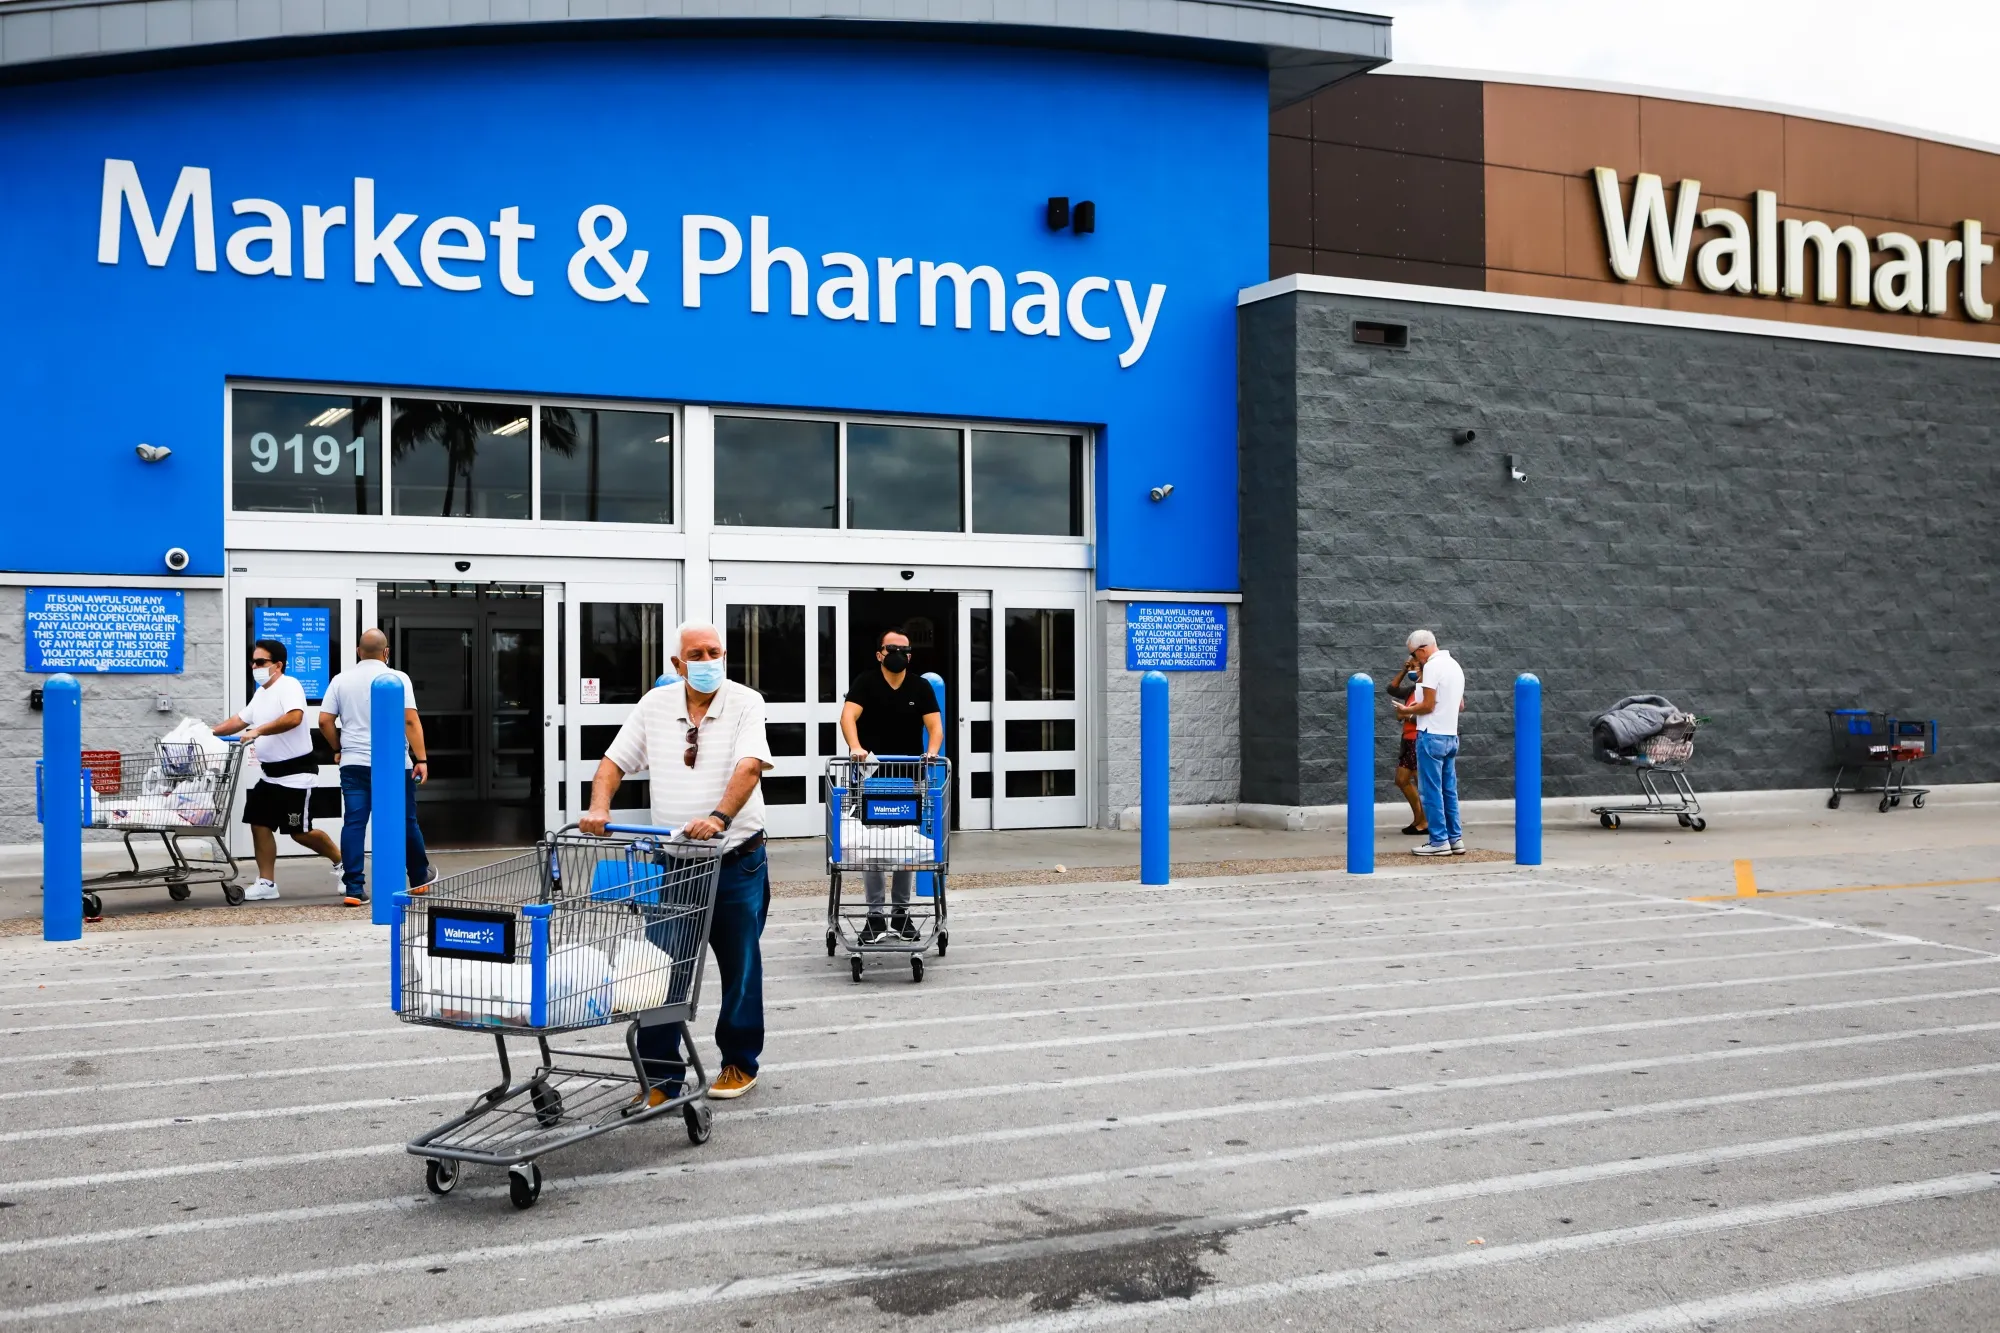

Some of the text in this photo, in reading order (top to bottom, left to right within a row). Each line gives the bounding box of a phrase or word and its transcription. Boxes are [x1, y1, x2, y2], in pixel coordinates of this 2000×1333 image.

[1594, 166, 1994, 321] Walmart
[97, 158, 1168, 369] Market & Pharmacy
[250, 432, 364, 476] 9191
[48, 594, 162, 604] IT IS UNLAWFUL FOR ANY
[45, 604, 82, 612] PERSON
[85, 604, 98, 612] TO
[29, 613, 69, 621] POSSESS
[72, 613, 81, 621] IN
[83, 613, 97, 621] AN
[98, 614, 124, 622] OPEN
[38, 622, 59, 630] ANY
[61, 622, 115, 631] ALCOHOLIC
[116, 623, 163, 631] BEVERAGE
[33, 631, 54, 639] THIS
[56, 631, 86, 639] STORE
[103, 632, 136, 640] WITHIN
[139, 632, 153, 640] 100
[39, 640, 52, 648] OF
[54, 640, 75, 648] ANY
[77, 640, 99, 648] PART
[101, 641, 114, 649] OF
[117, 641, 137, 649] THIS
[42, 649, 94, 657] VIOLATORS
[116, 650, 155, 658] SUBJECT
[156, 650, 168, 658] TO
[41, 658, 77, 666] ARREST
[78, 658, 98, 667] AND
[444, 928, 481, 939] Walmart
